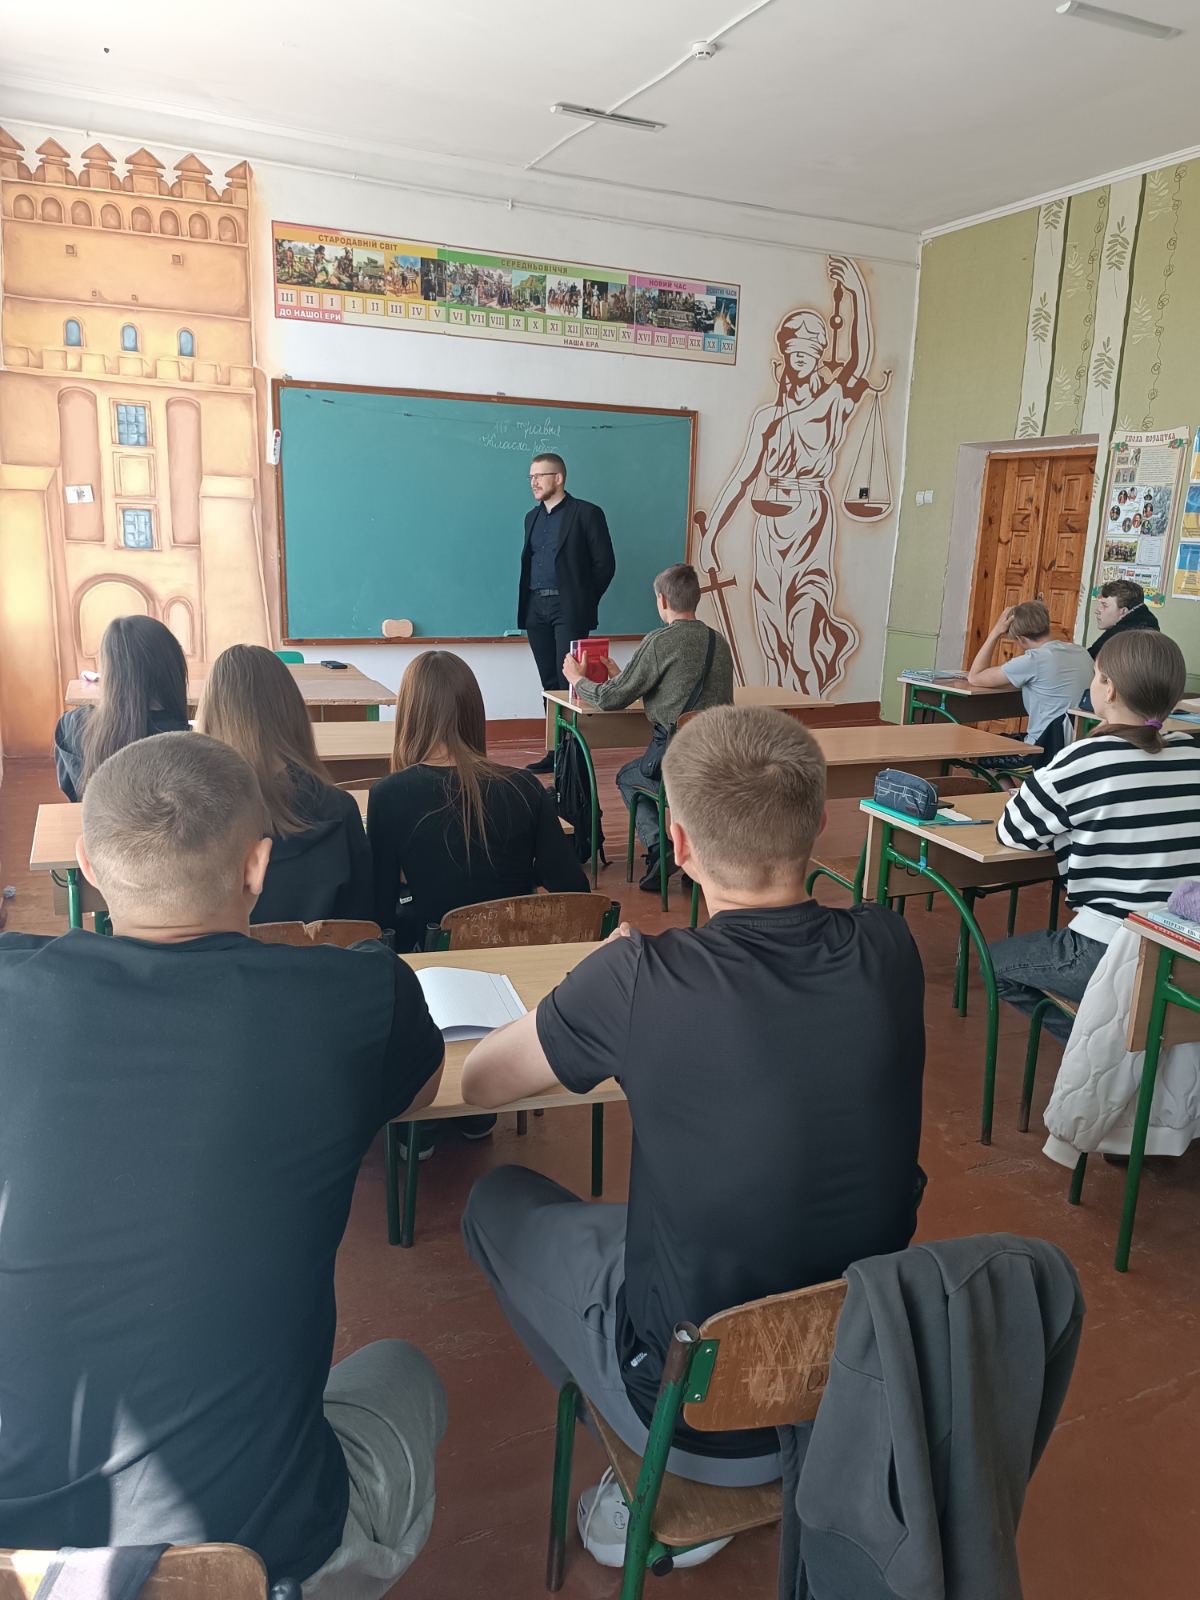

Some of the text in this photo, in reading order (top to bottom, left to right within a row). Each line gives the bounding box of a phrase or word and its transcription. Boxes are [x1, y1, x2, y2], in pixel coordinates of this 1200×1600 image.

[318, 234, 398, 251] СТАРОДАВНІЙ СВІТ
[501, 259, 568, 274] СЕРЕДНЬОВІЧЧЯ
[649, 279, 687, 290] НОВИЙ ЧАС
[280, 292, 293, 302] III
[306, 296, 314, 304] II
[280, 308, 292, 316] ДО
[294, 310, 322, 319] НАШОЇ
[371, 302, 379, 312] II
[390, 304, 402, 314] III
[412, 306, 422, 316] IV
[434, 309, 441, 318] V
[453, 312, 463, 320] VI
[471, 314, 485, 323] VII
[490, 316, 505, 326] VIII
[512, 318, 521, 328] IX
[533, 321, 539, 330] X
[550, 322, 559, 331] XI
[568, 324, 578, 334] XII
[584, 327, 598, 336] XIII
[602, 328, 615, 338] XIV
[622, 330, 632, 339] XV
[638, 333, 651, 342] XVI
[722, 342, 733, 351] XXI
[564, 339, 599, 348] НАША ЕРА
